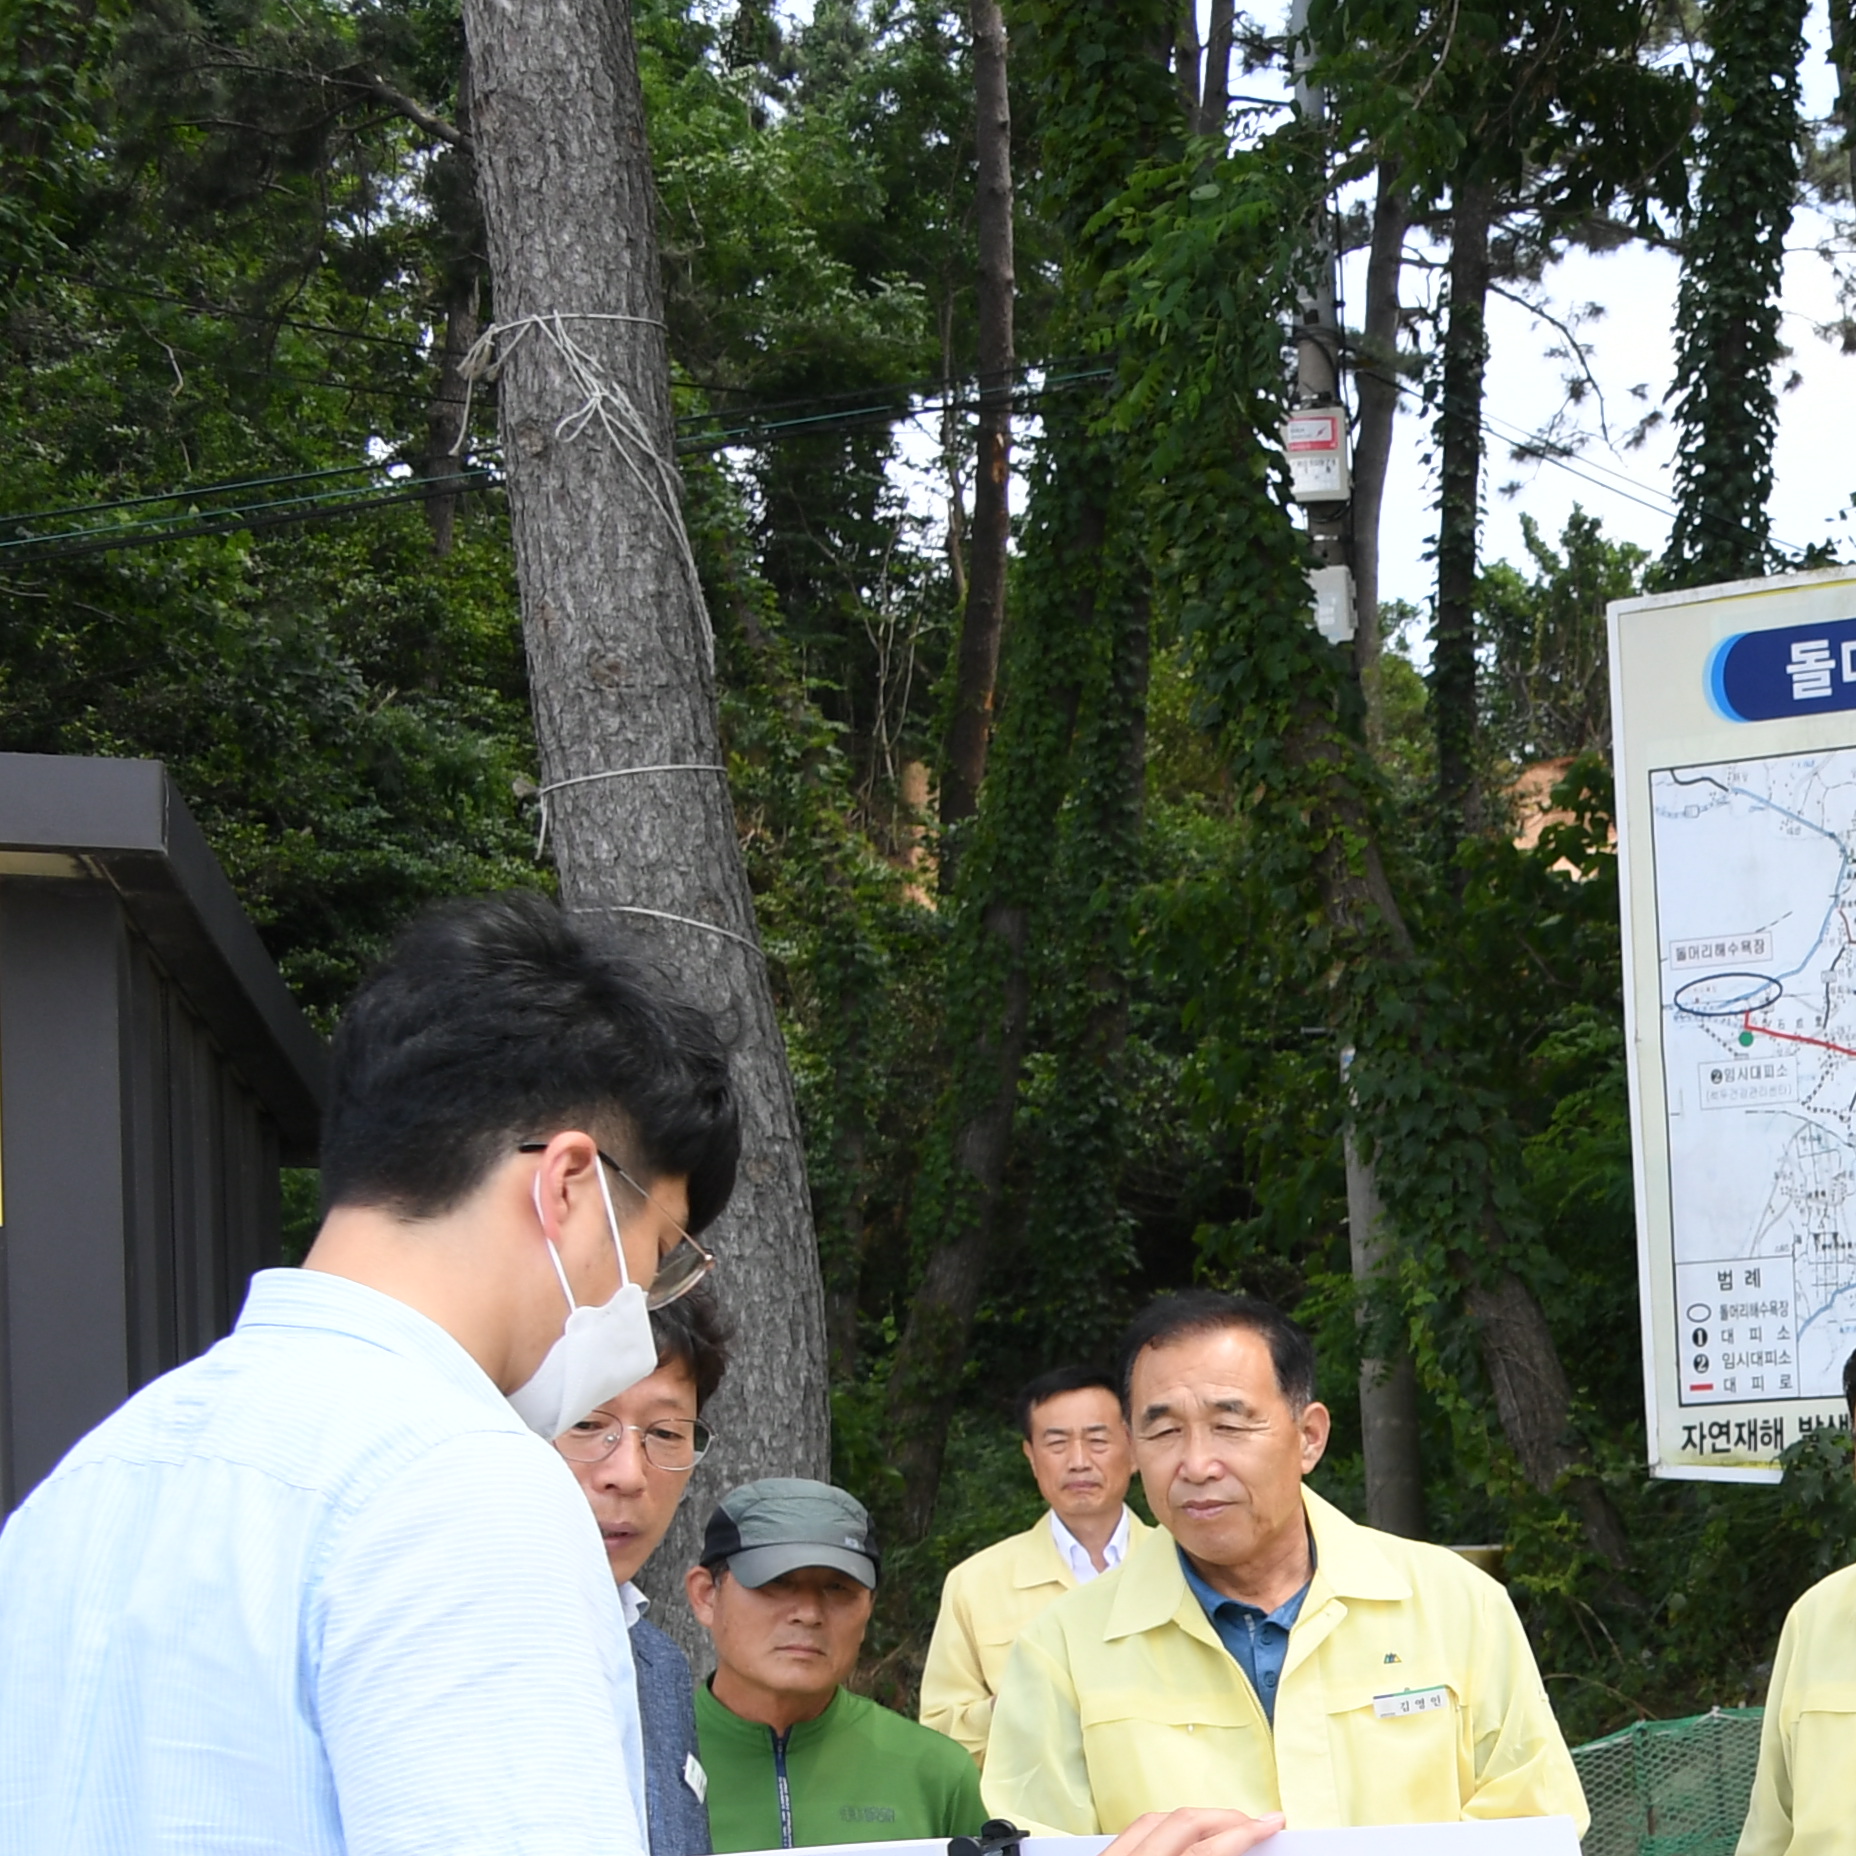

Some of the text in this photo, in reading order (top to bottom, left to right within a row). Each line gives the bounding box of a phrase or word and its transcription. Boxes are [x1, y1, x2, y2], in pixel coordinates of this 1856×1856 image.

[1675, 937, 1765, 962] 돌머리해수욕장
[1722, 1349, 1792, 1370] 임시대피소
[1681, 1416, 1785, 1456] 자연재해
